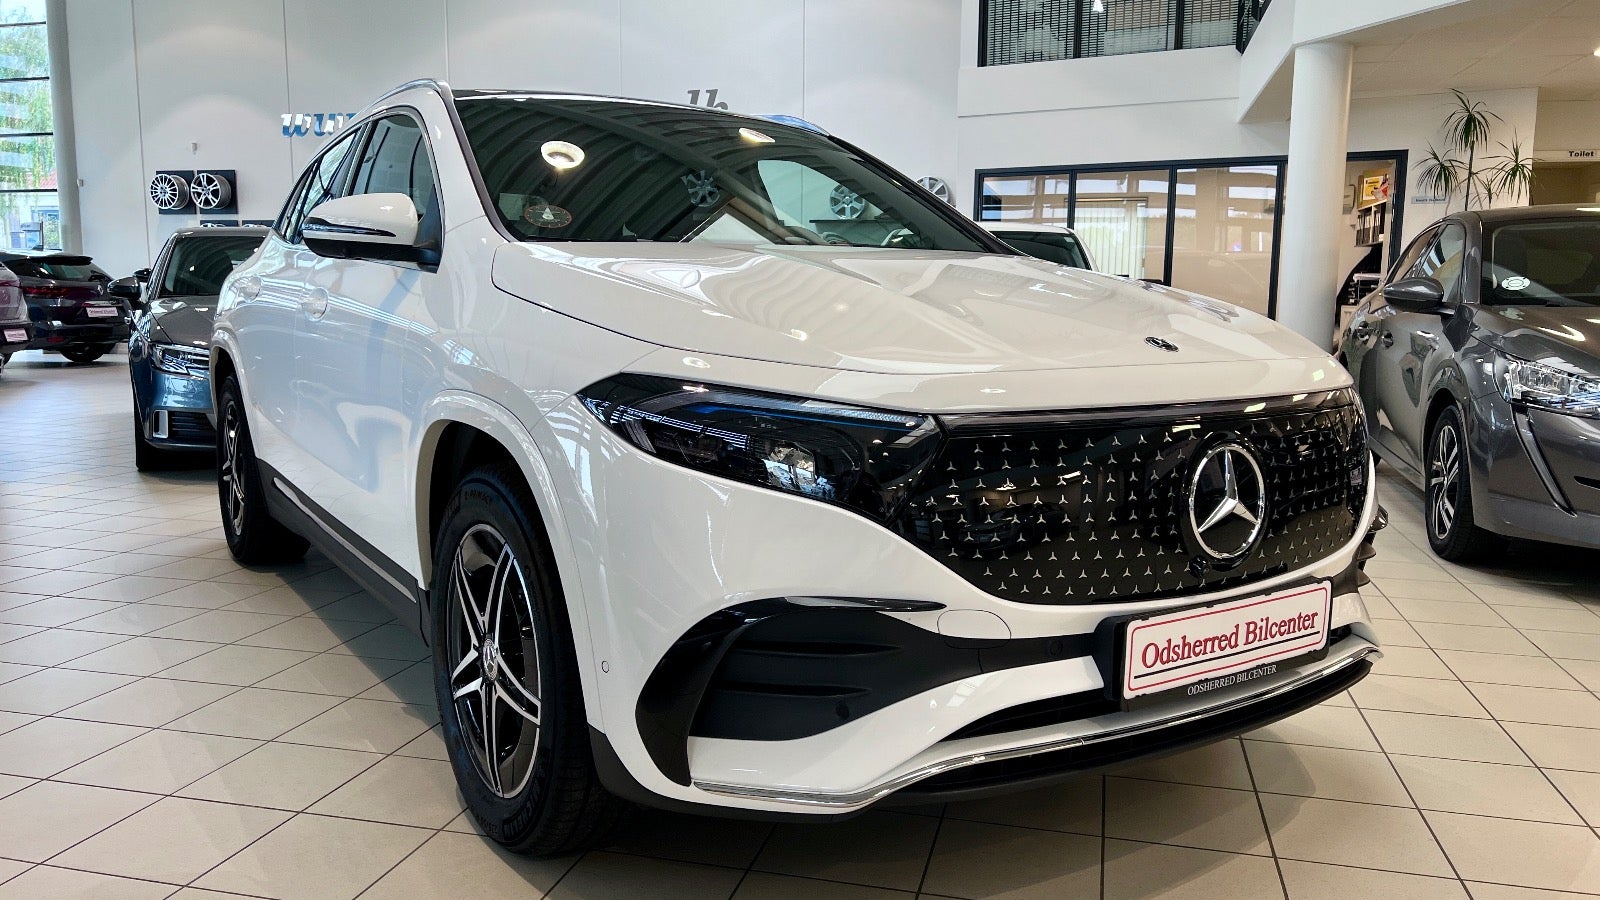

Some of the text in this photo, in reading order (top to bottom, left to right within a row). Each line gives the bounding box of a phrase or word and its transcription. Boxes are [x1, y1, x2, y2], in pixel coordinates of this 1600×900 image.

[1568, 150, 1594, 158] Toilet
[1141, 611, 1319, 669] Odsherred Bilcenter
[1187, 664, 1277, 697] ODSHERRED BILCENTER
